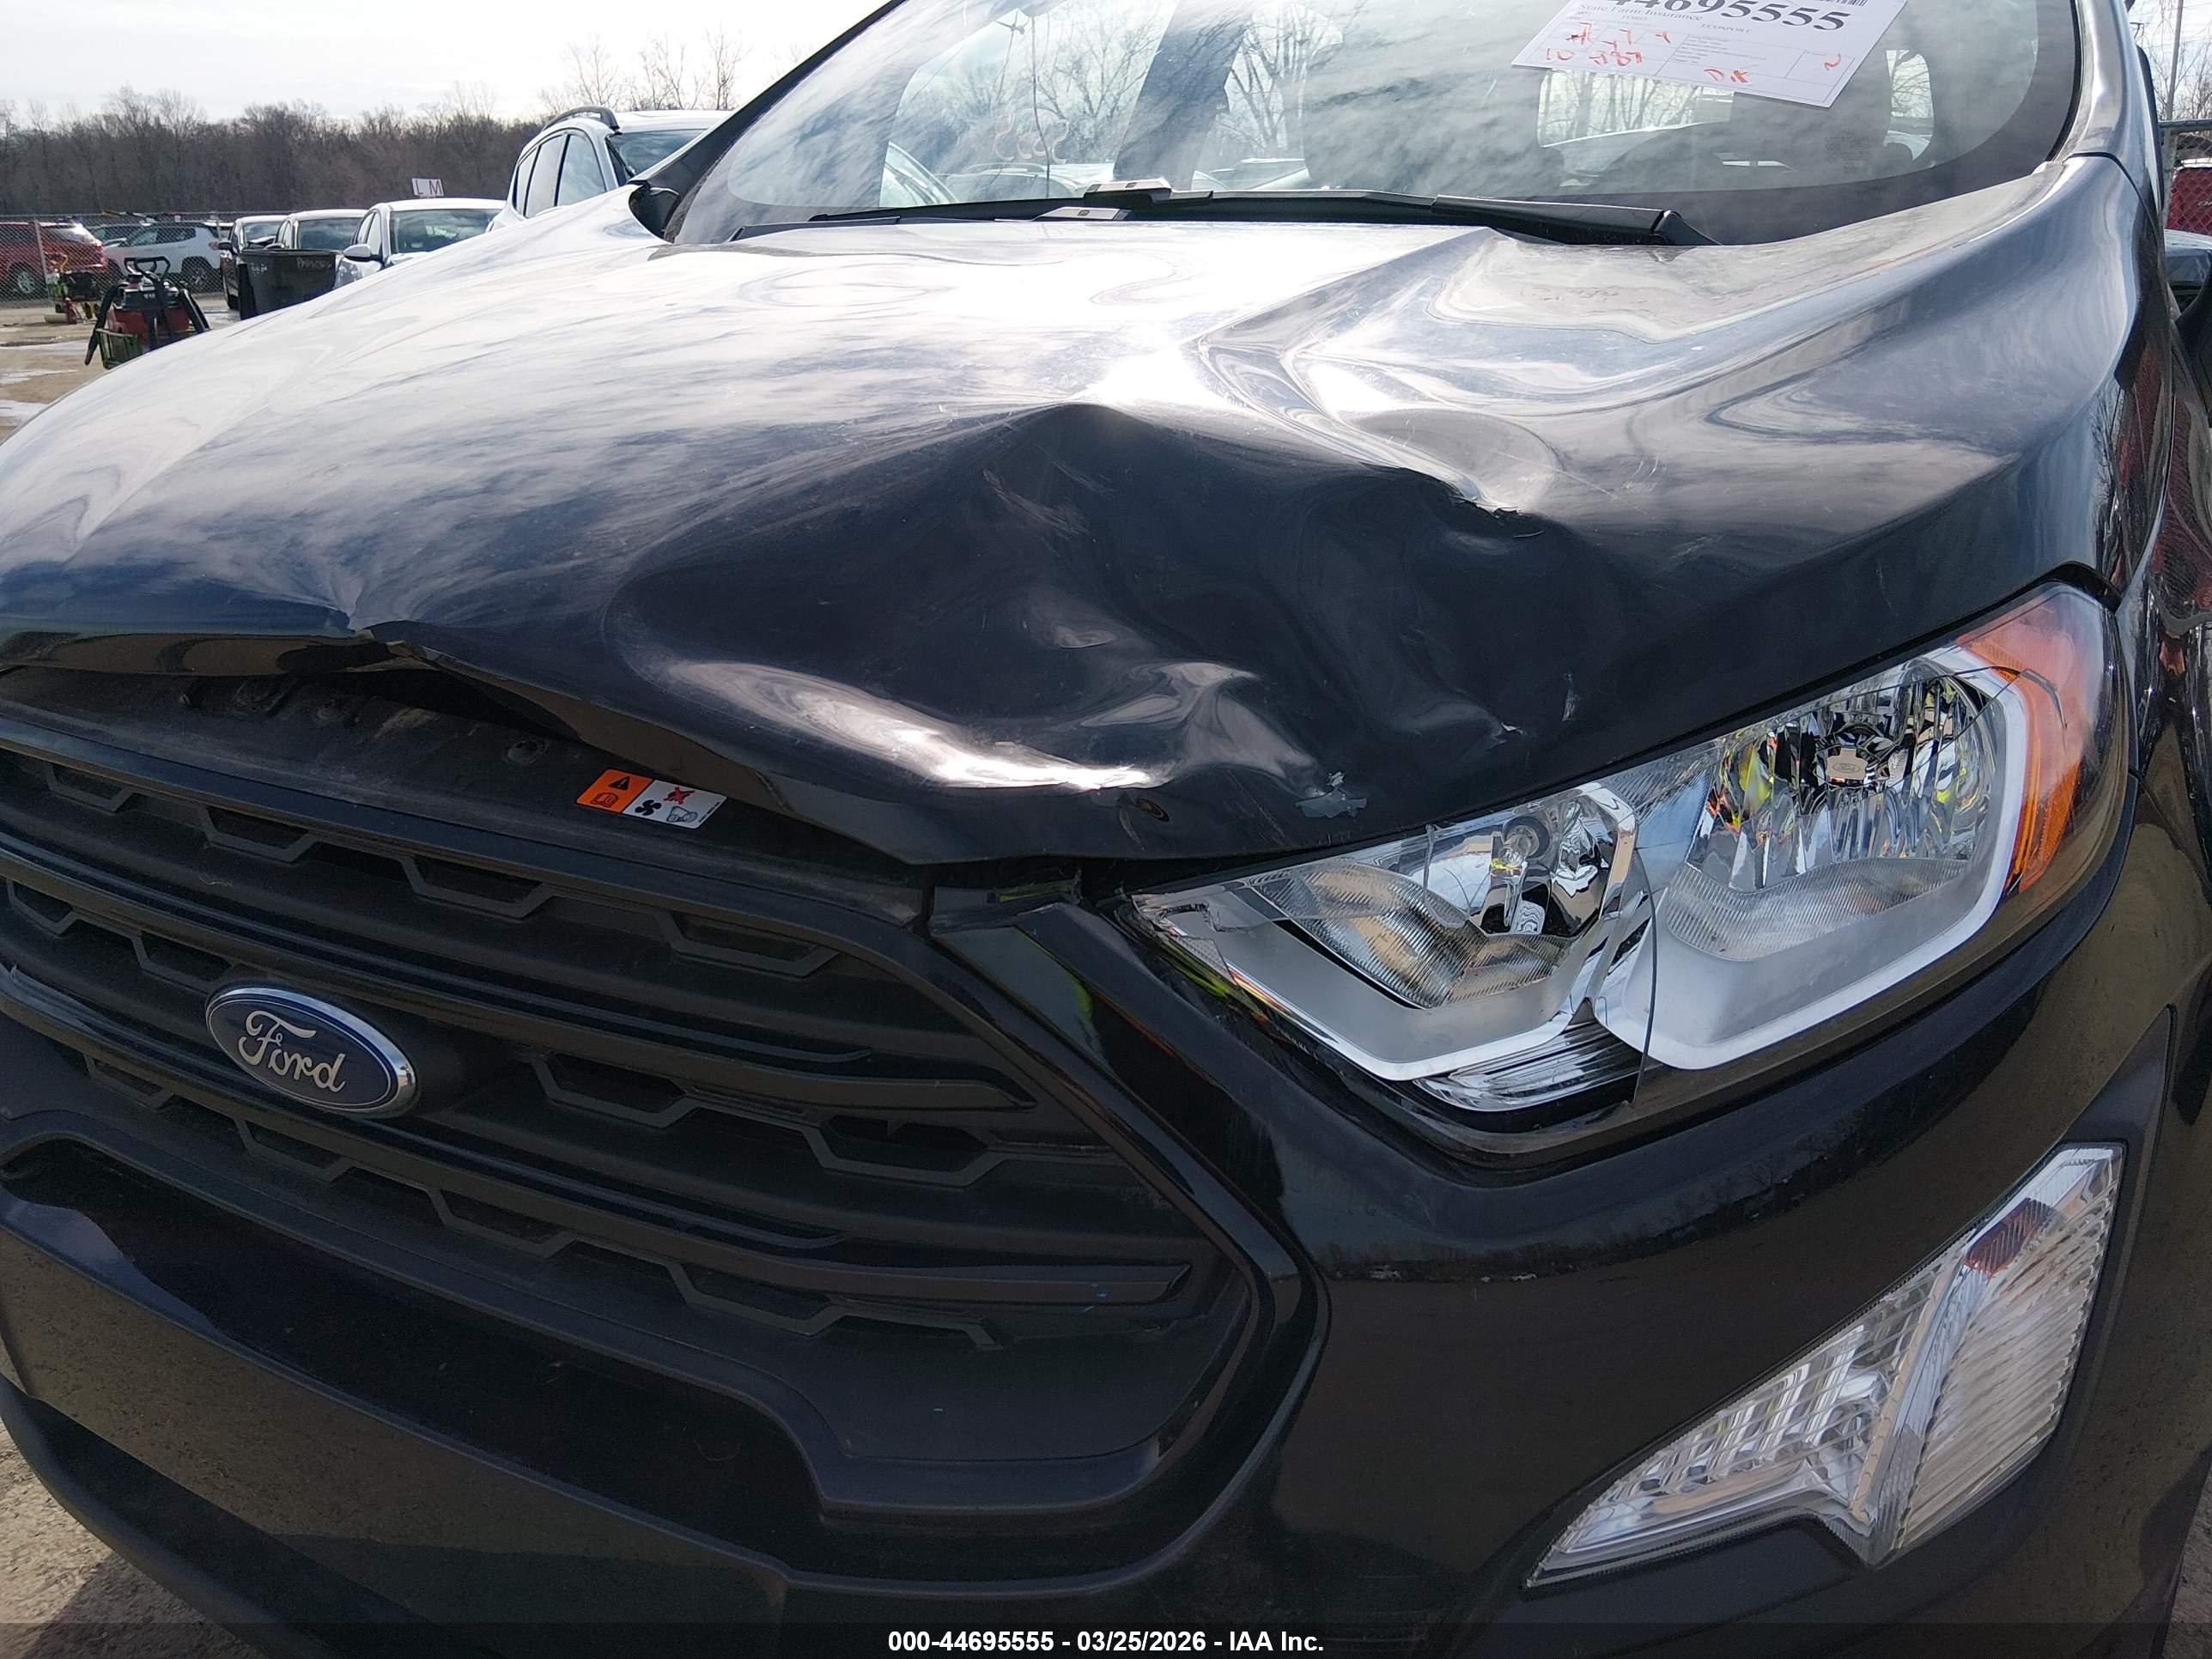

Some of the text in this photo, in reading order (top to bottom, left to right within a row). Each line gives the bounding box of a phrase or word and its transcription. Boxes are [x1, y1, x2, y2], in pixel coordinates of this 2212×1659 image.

[1580, 3, 1704, 21] State Farm Insurance
[1607, 0, 1851, 31] 695555
[238, 1010, 346, 1092] Ford
